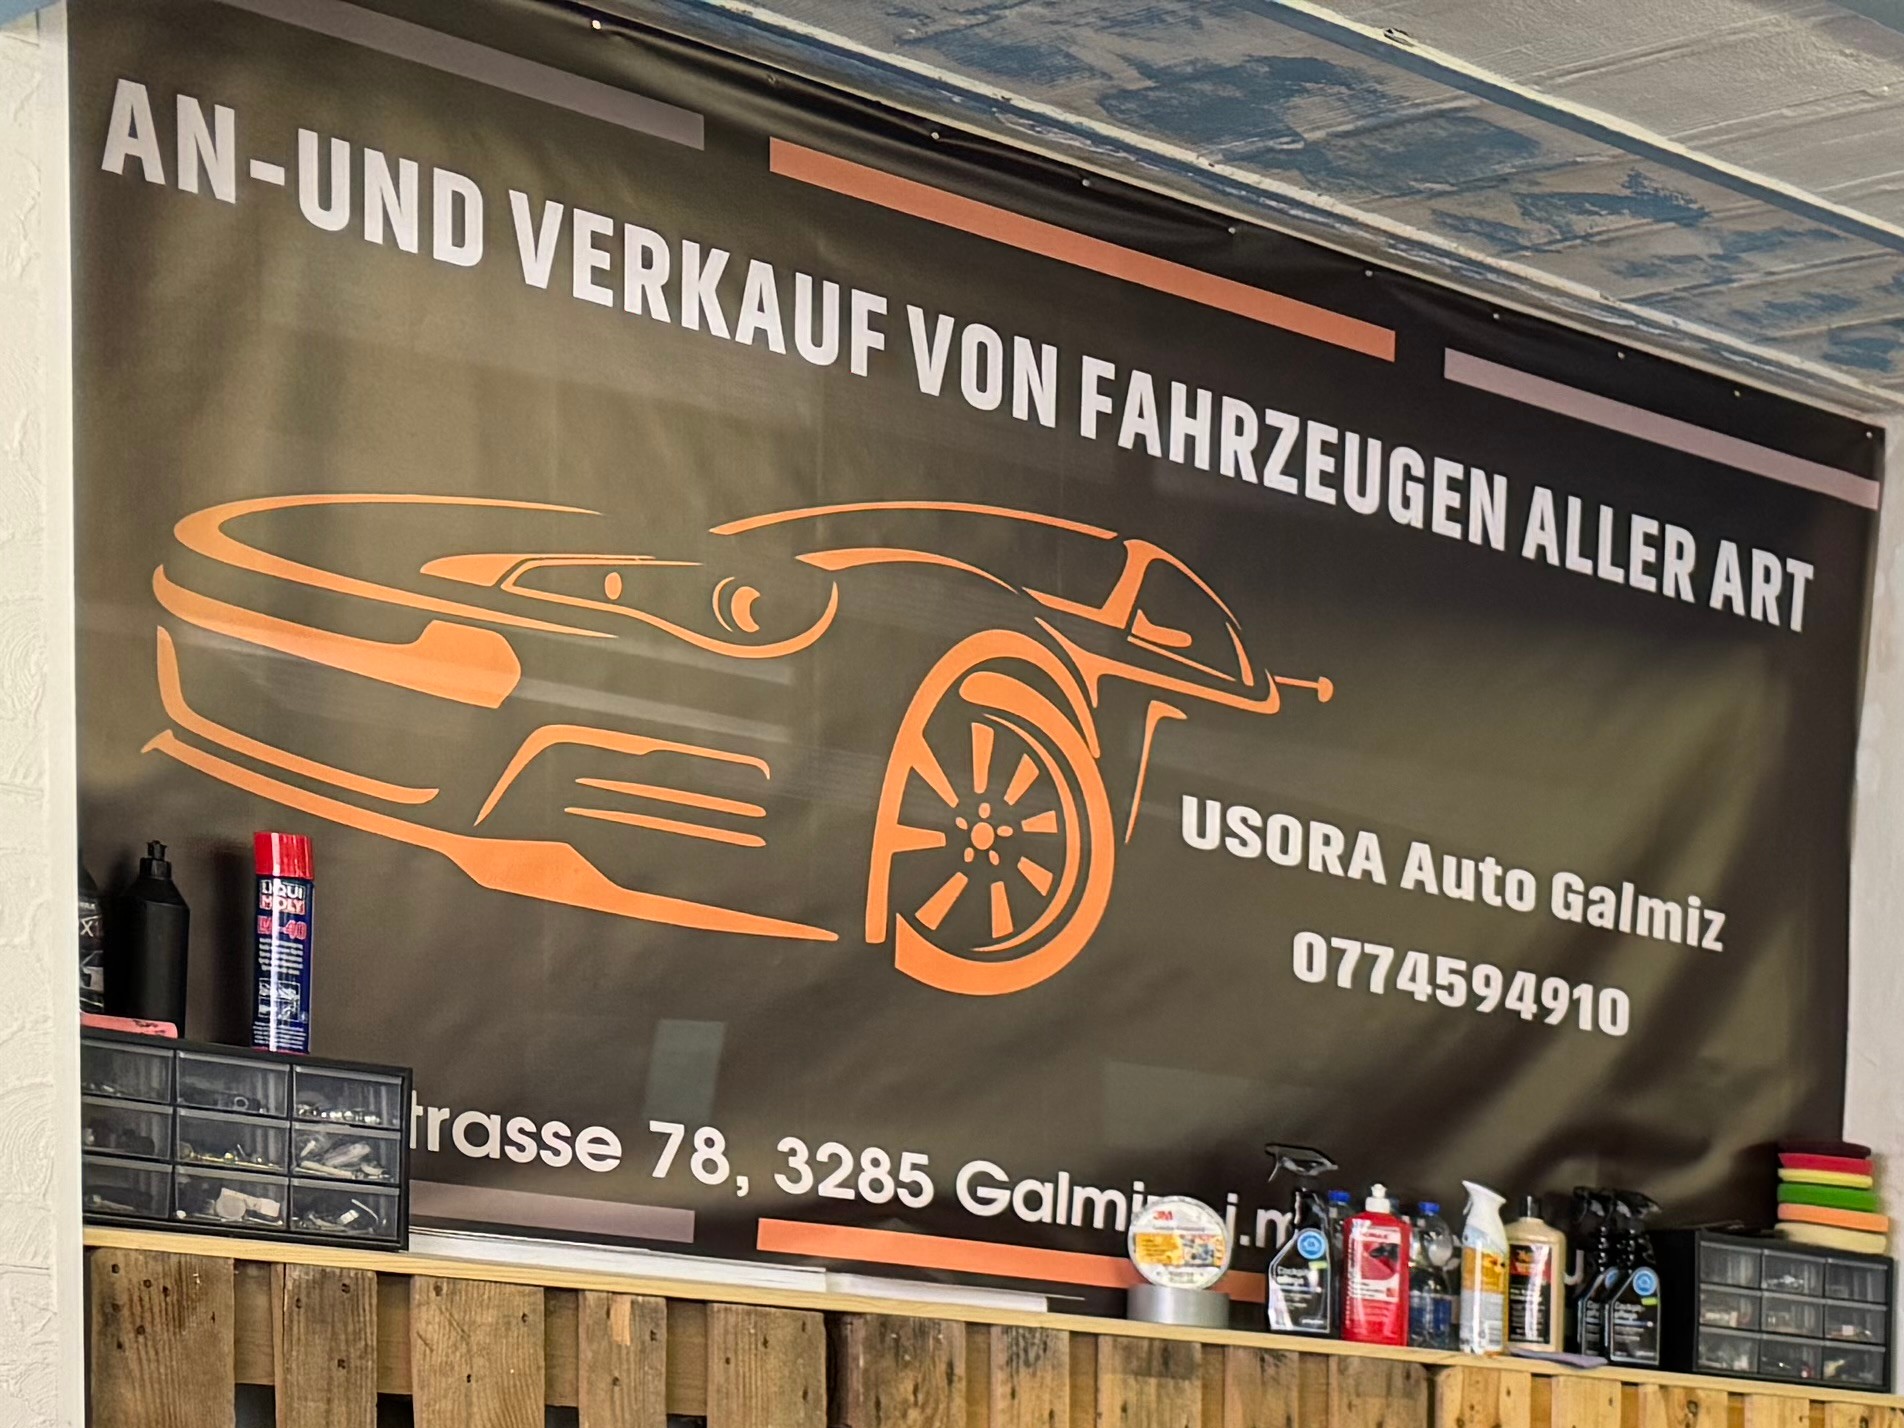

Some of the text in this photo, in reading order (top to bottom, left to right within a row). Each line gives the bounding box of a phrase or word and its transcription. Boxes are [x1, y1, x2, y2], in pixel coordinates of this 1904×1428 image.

[102, 78, 1814, 632] AN-UND VERKAUF VON FAHRZEUGEN ALLER ART
[1181, 795, 1727, 952] USORA Auto Galmiz
[1293, 931, 1630, 1036] 0774594910
[647, 1122, 749, 1197] 78,
[773, 1135, 935, 1209] 3285
[956, 1159, 1164, 1233] Galmi
[1153, 1210, 1173, 1221] 3M
